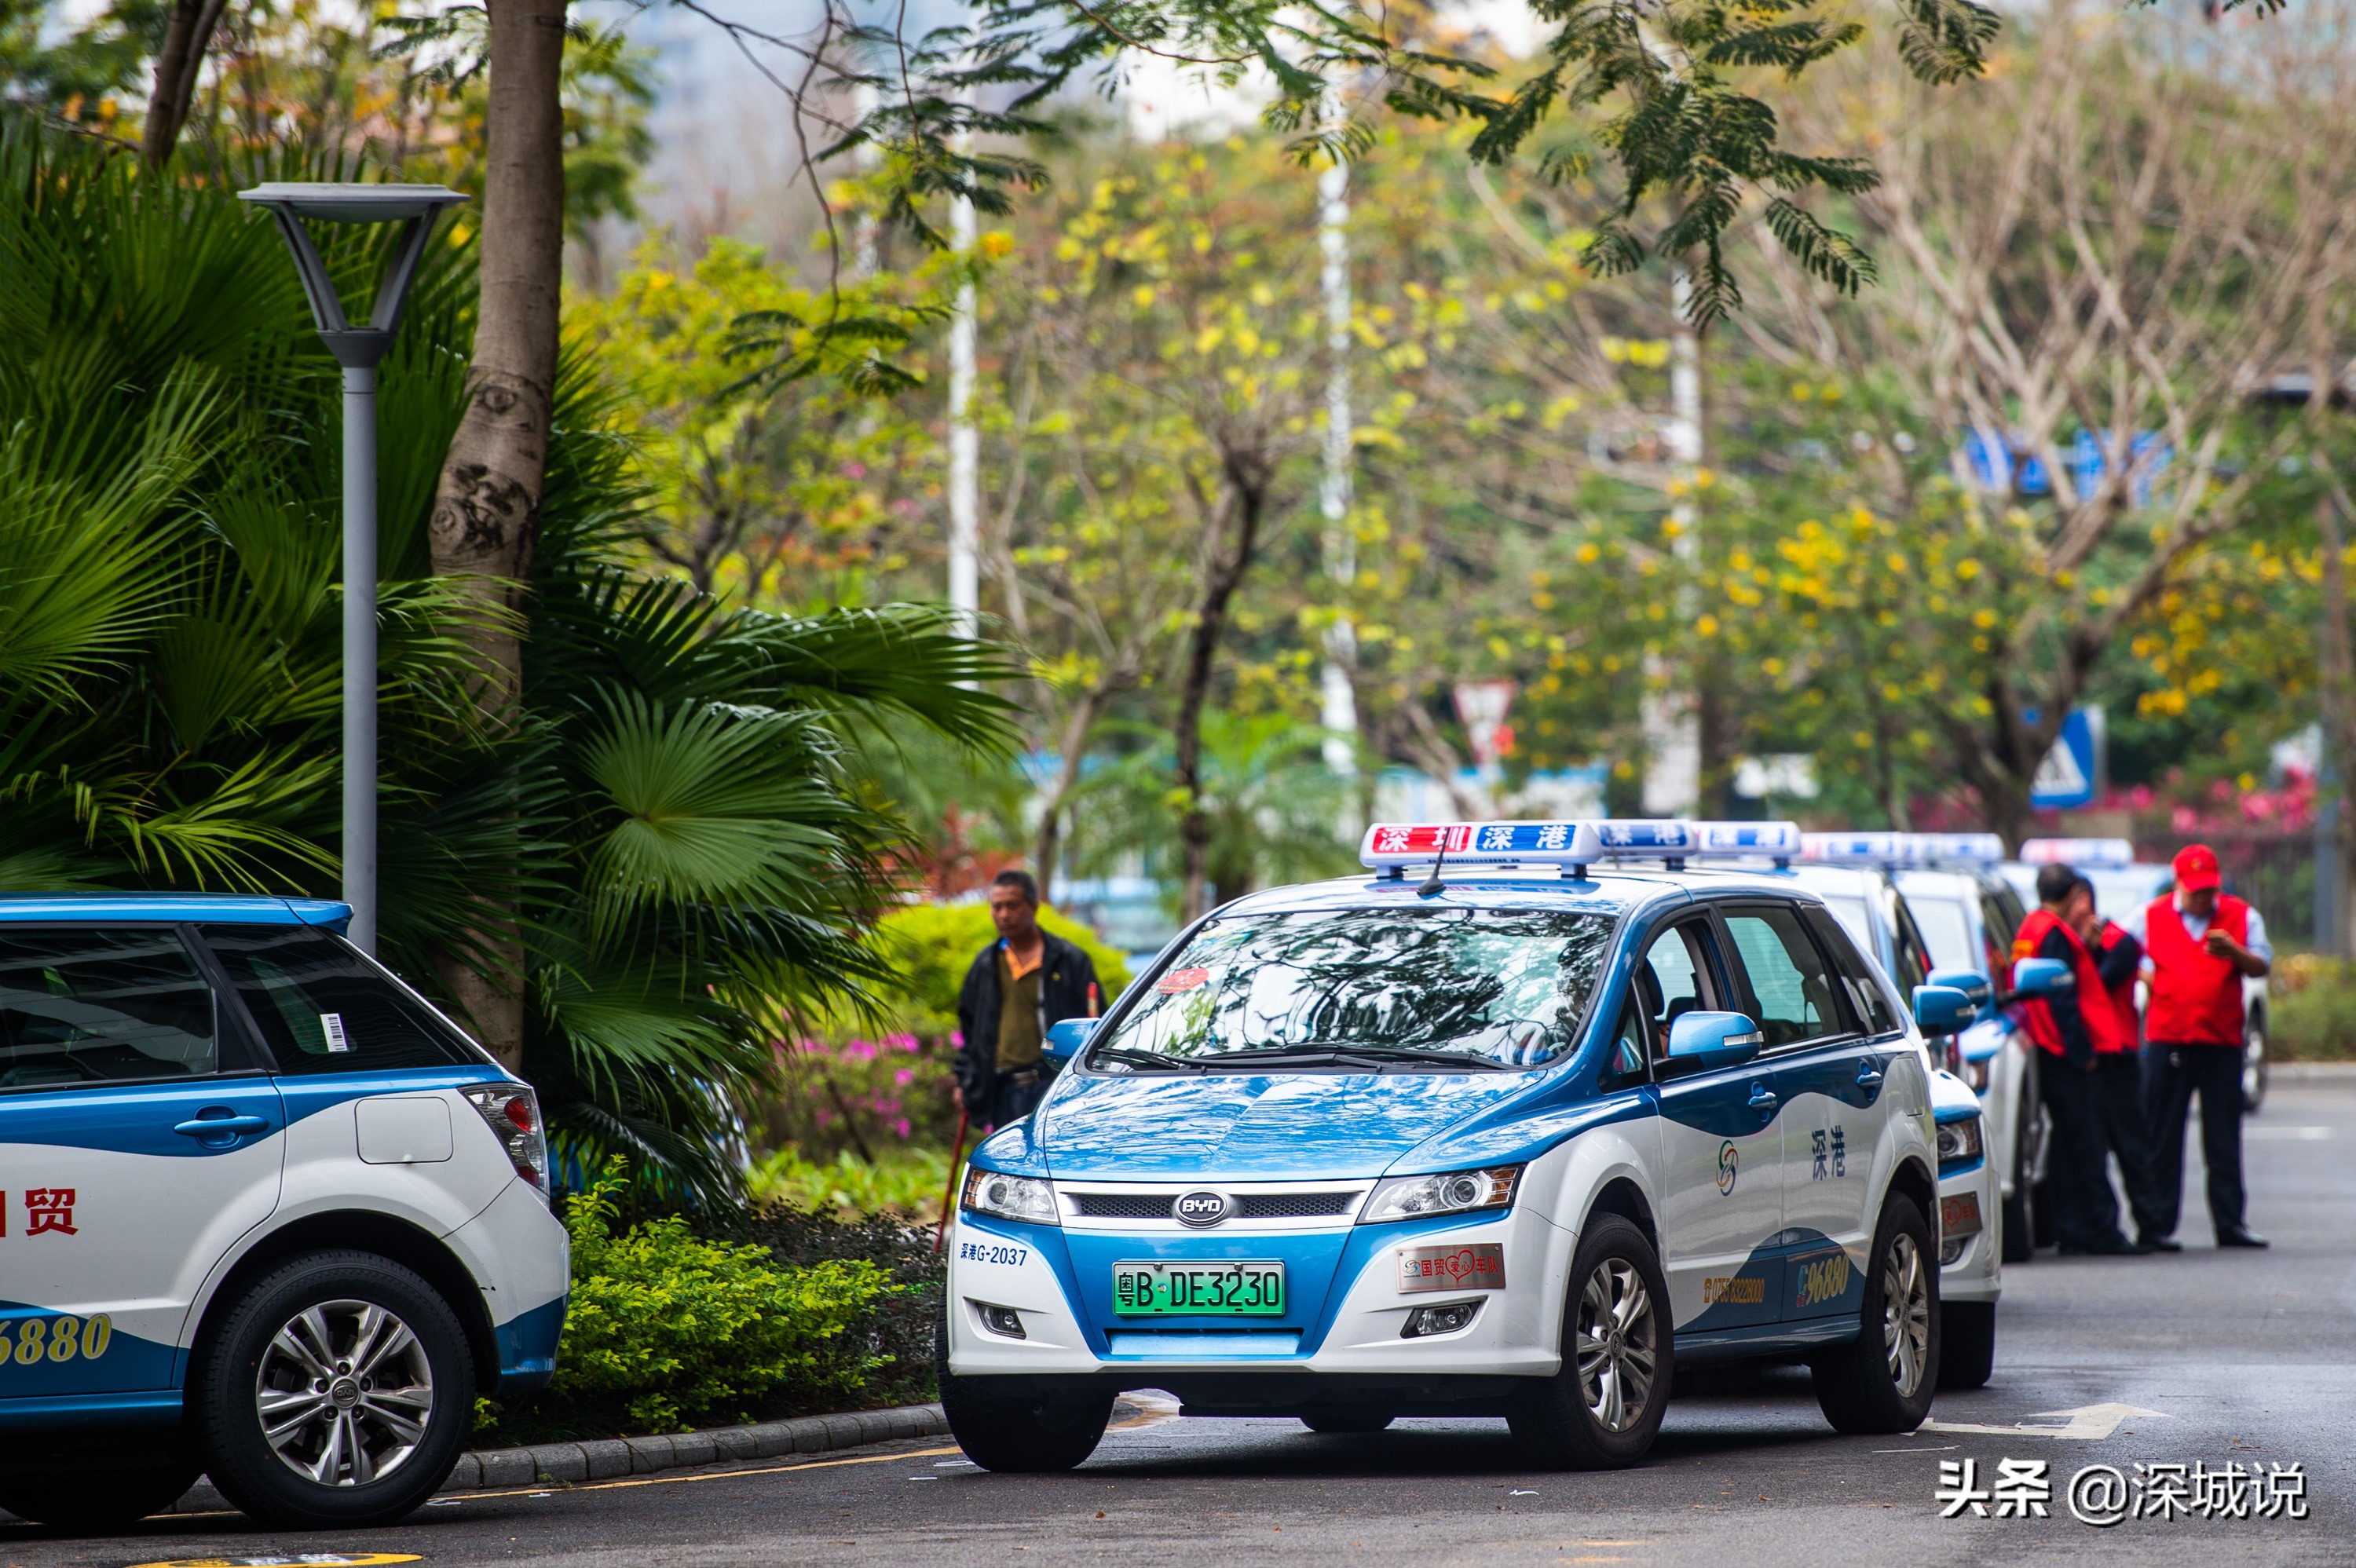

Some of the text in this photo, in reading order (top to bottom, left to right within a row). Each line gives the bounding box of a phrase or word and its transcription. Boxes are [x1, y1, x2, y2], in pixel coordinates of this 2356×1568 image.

[1377, 826, 1463, 852] 深圳
[1481, 825, 1568, 850] 深港
[1811, 1124, 1846, 1181] 深港
[0, 1187, 79, 1237] 贸
[1182, 1199, 1221, 1212] BYD
